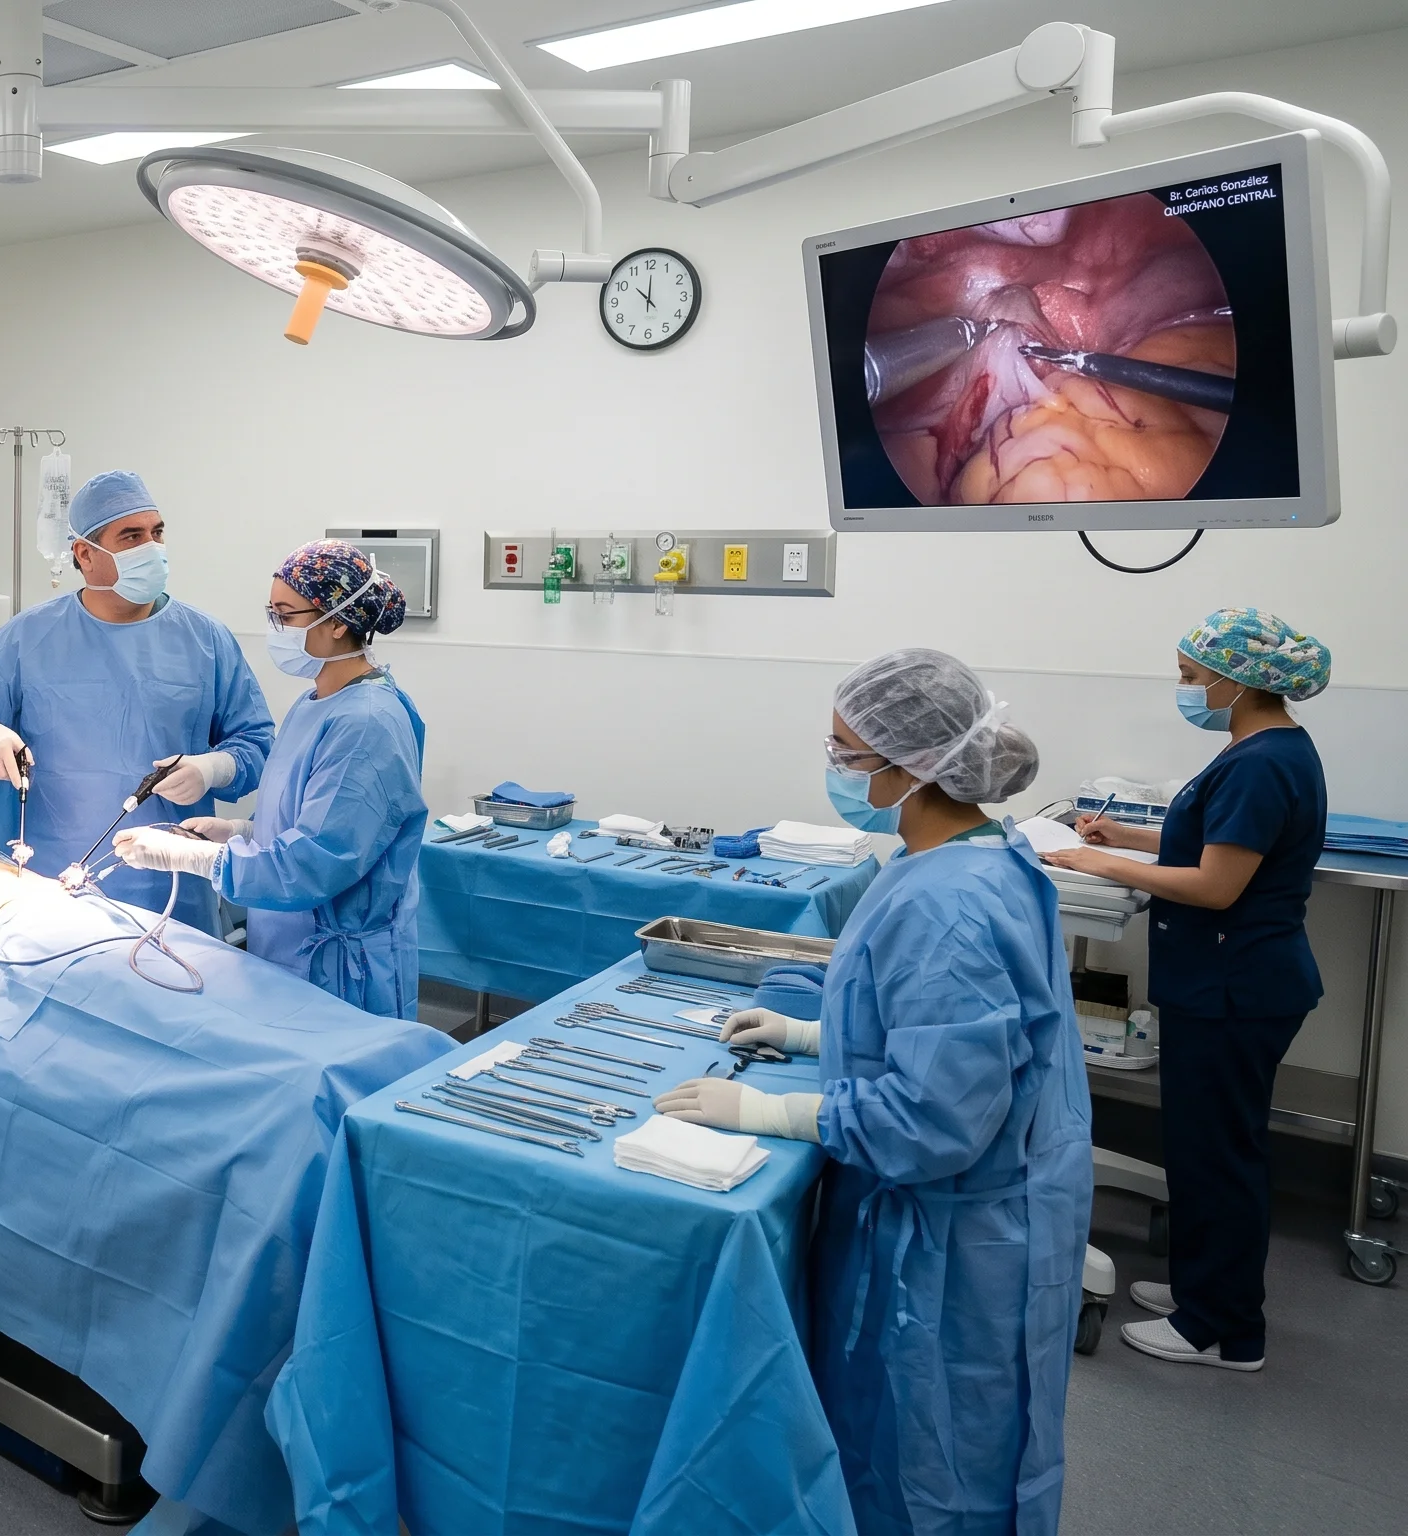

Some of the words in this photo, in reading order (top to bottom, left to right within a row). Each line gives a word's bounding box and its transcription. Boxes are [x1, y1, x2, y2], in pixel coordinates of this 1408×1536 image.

[1164, 197, 1225, 216] QUIRÓFANO
[1227, 188, 1276, 205] CENTRAL
[644, 259, 657, 270] 12
[664, 263, 669, 273] 1
[629, 266, 639, 276] 11
[675, 274, 684, 285] 2
[615, 280, 629, 292] 10
[679, 291, 688, 302] 3
[610, 297, 619, 308] 9
[615, 313, 624, 324] 8
[674, 309, 682, 319] 4
[628, 324, 636, 335] 7
[661, 322, 670, 333] 5
[644, 328, 653, 339] 6
